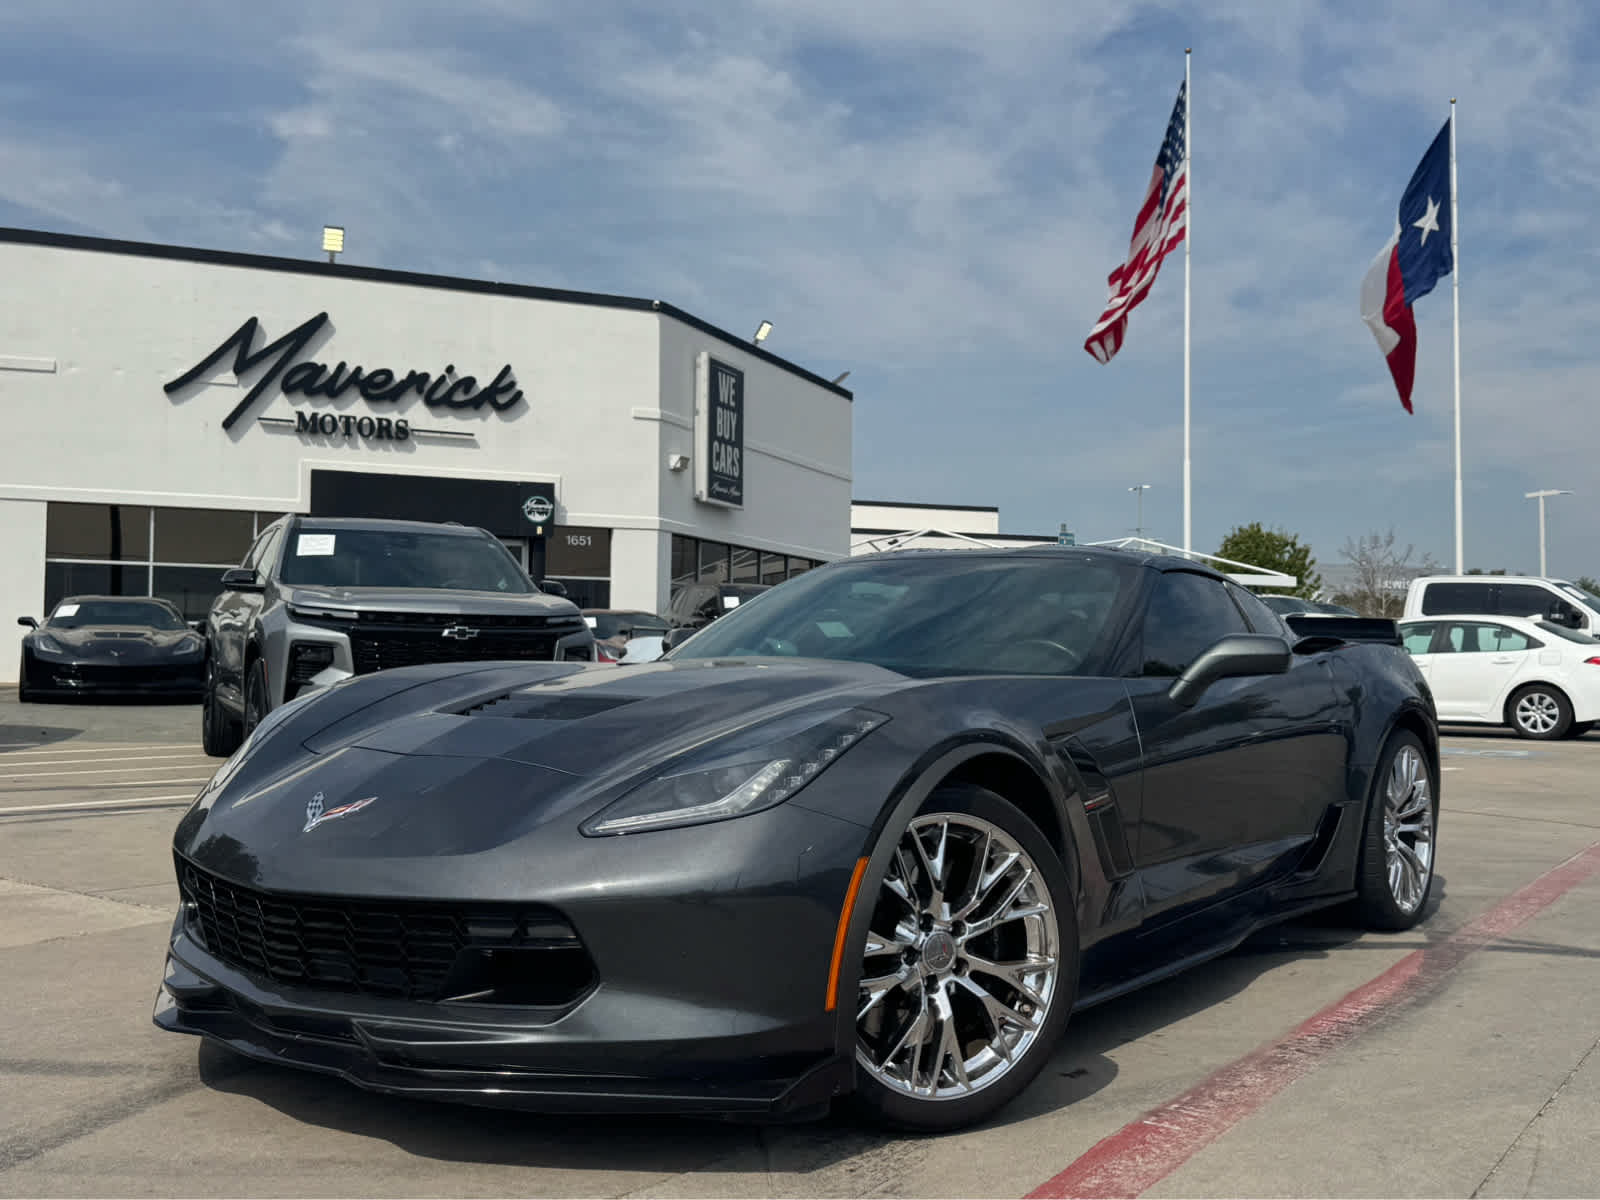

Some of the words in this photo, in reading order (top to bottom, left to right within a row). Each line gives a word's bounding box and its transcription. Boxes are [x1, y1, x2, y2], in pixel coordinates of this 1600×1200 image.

[163, 311, 524, 430] Maverick
[718, 372, 736, 406] WE
[294, 410, 410, 441] MOTORS
[716, 407, 736, 440] BUY
[712, 441, 739, 477] CARS
[566, 535, 592, 546] 1651
